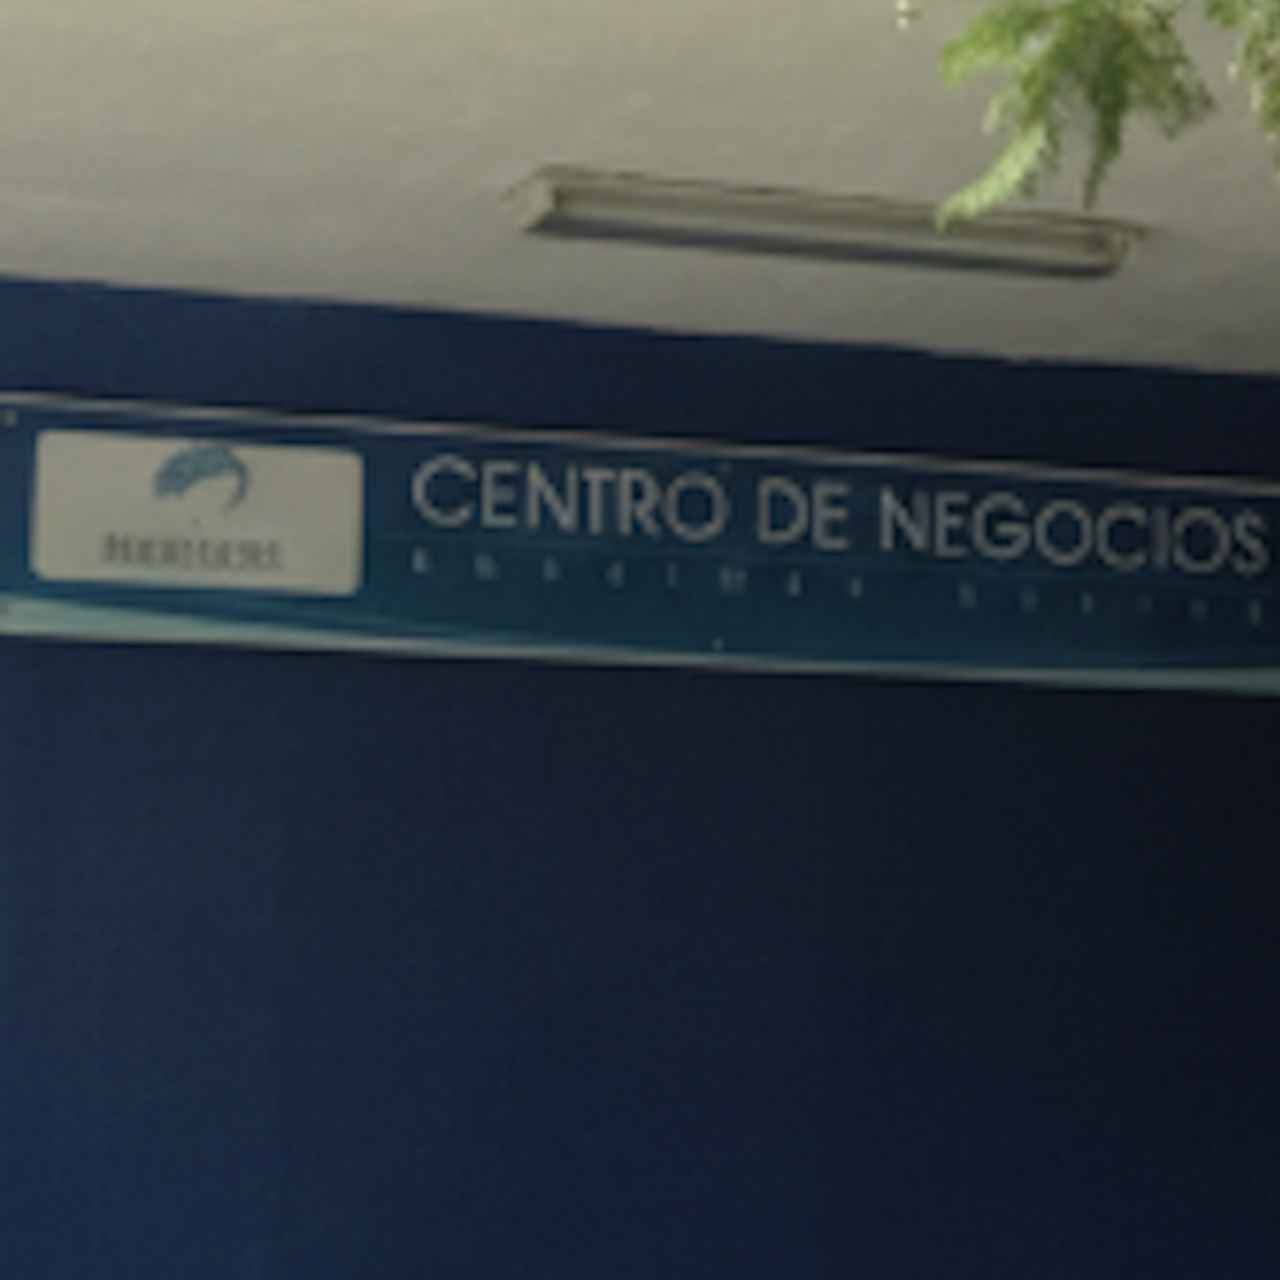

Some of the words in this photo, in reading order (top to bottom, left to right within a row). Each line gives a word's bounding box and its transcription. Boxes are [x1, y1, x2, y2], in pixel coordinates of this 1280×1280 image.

[411, 454, 729, 543] CENTRO
[756, 476, 850, 551] DE
[878, 486, 1269, 575] NEGOCIOS
